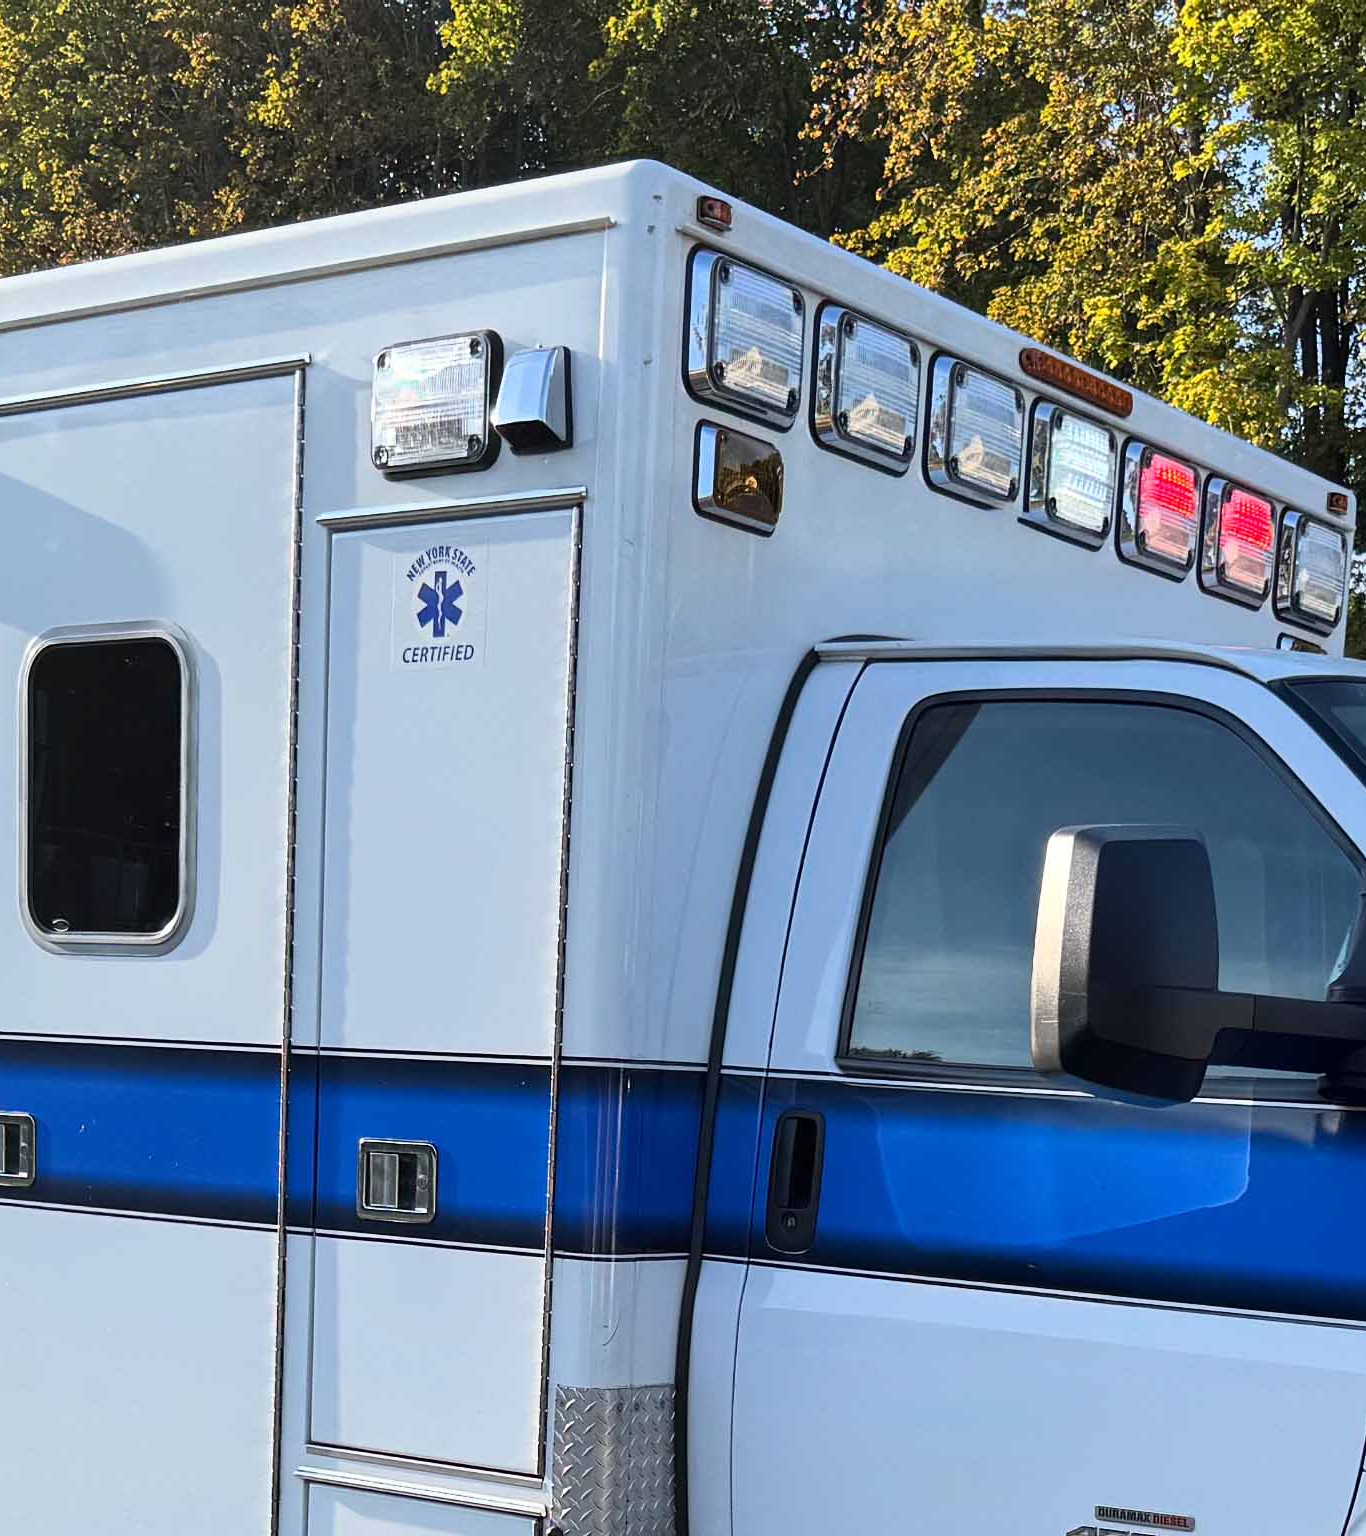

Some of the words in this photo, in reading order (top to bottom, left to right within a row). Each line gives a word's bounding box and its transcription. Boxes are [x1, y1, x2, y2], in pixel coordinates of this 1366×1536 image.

[406, 554, 425, 582] NEW
[425, 545, 452, 561] YORK
[452, 548, 476, 576] STATE
[402, 644, 475, 664] CERTIFIED
[1098, 1506, 1152, 1523] DURAMAX
[1153, 1514, 1189, 1529] DIESEL
